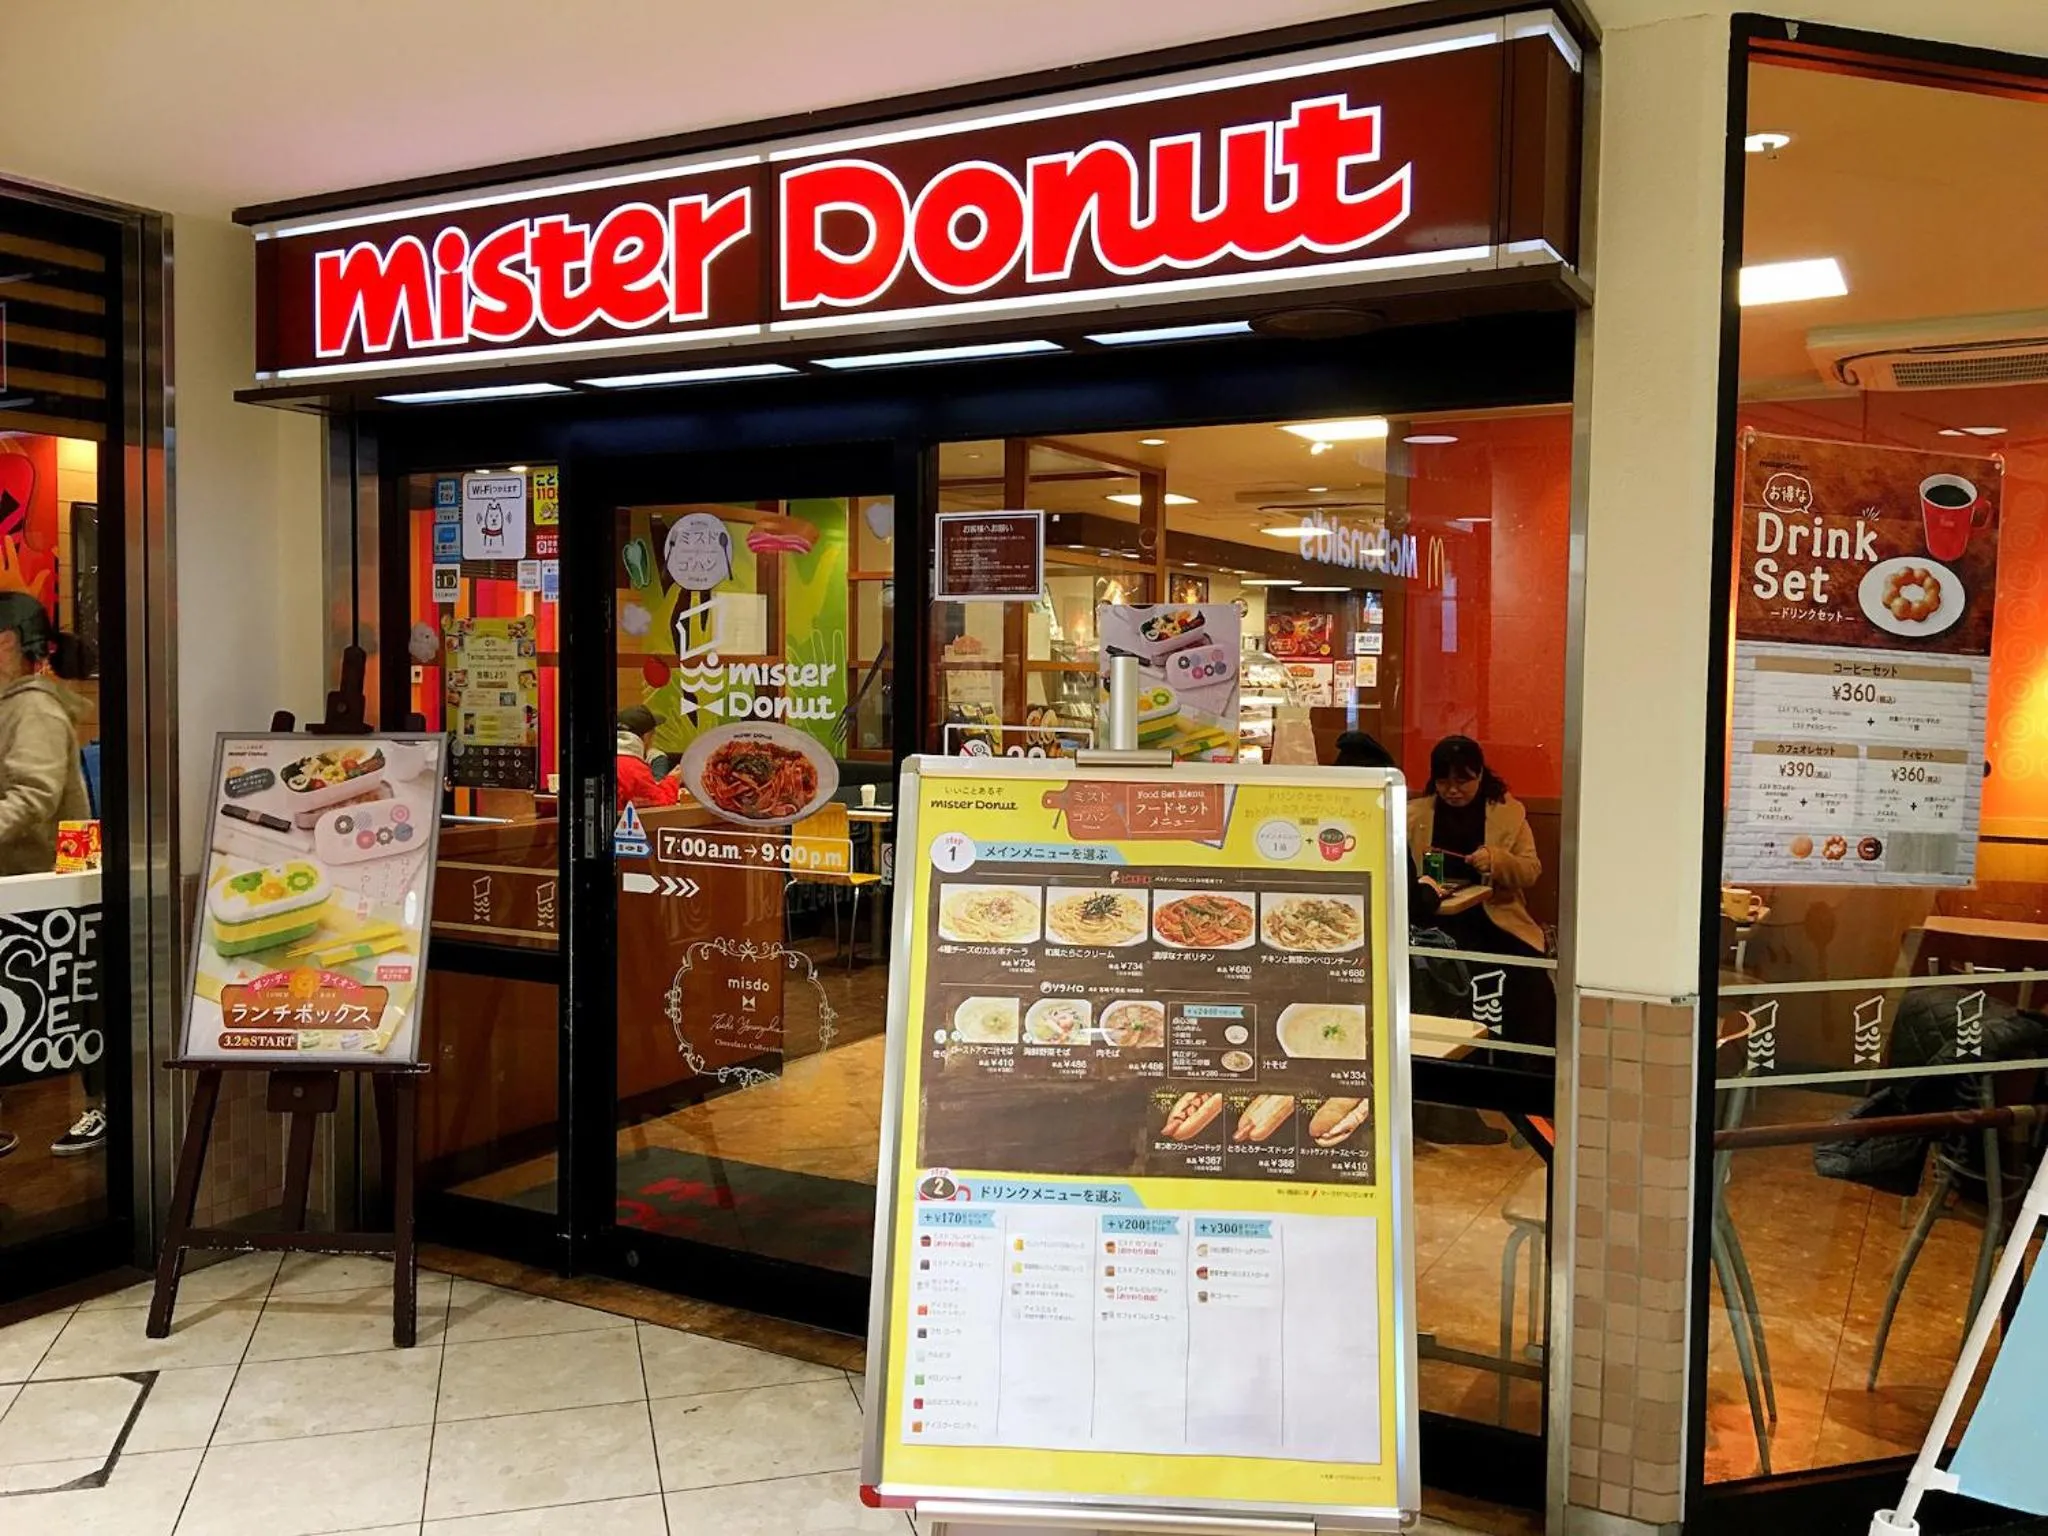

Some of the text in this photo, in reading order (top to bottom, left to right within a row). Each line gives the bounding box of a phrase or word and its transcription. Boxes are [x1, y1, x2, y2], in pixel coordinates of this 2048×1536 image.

[315, 94, 1412, 358] mister Donut
[1769, 485, 1807, 503] お得な
[1756, 511, 1879, 563] Drink
[1753, 557, 1831, 604] Set
[1781, 608, 1844, 623] ドリンクセット
[728, 661, 837, 688] mister
[1833, 662, 1899, 678] コーヒーセット
[1832, 682, 1877, 703] ¥360
[728, 691, 837, 721] Donut
[1776, 744, 1836, 756] カフェオレセット
[1780, 761, 1815, 778] ¥390
[1891, 766, 1926, 782] ¥360
[930, 799, 1018, 810] mister Donut
[1135, 802, 1210, 816] フードセット
[1149, 817, 1196, 828] メニュー
[948, 845, 957, 861] 1
[985, 846, 1109, 861] メインメニューを選ぶ
[728, 976, 770, 992] misdo
[231, 1003, 372, 1025] ランチボックス
[933, 1178, 944, 1195] 2
[980, 1186, 1122, 1204] ドリンクメニューを選ぶ
